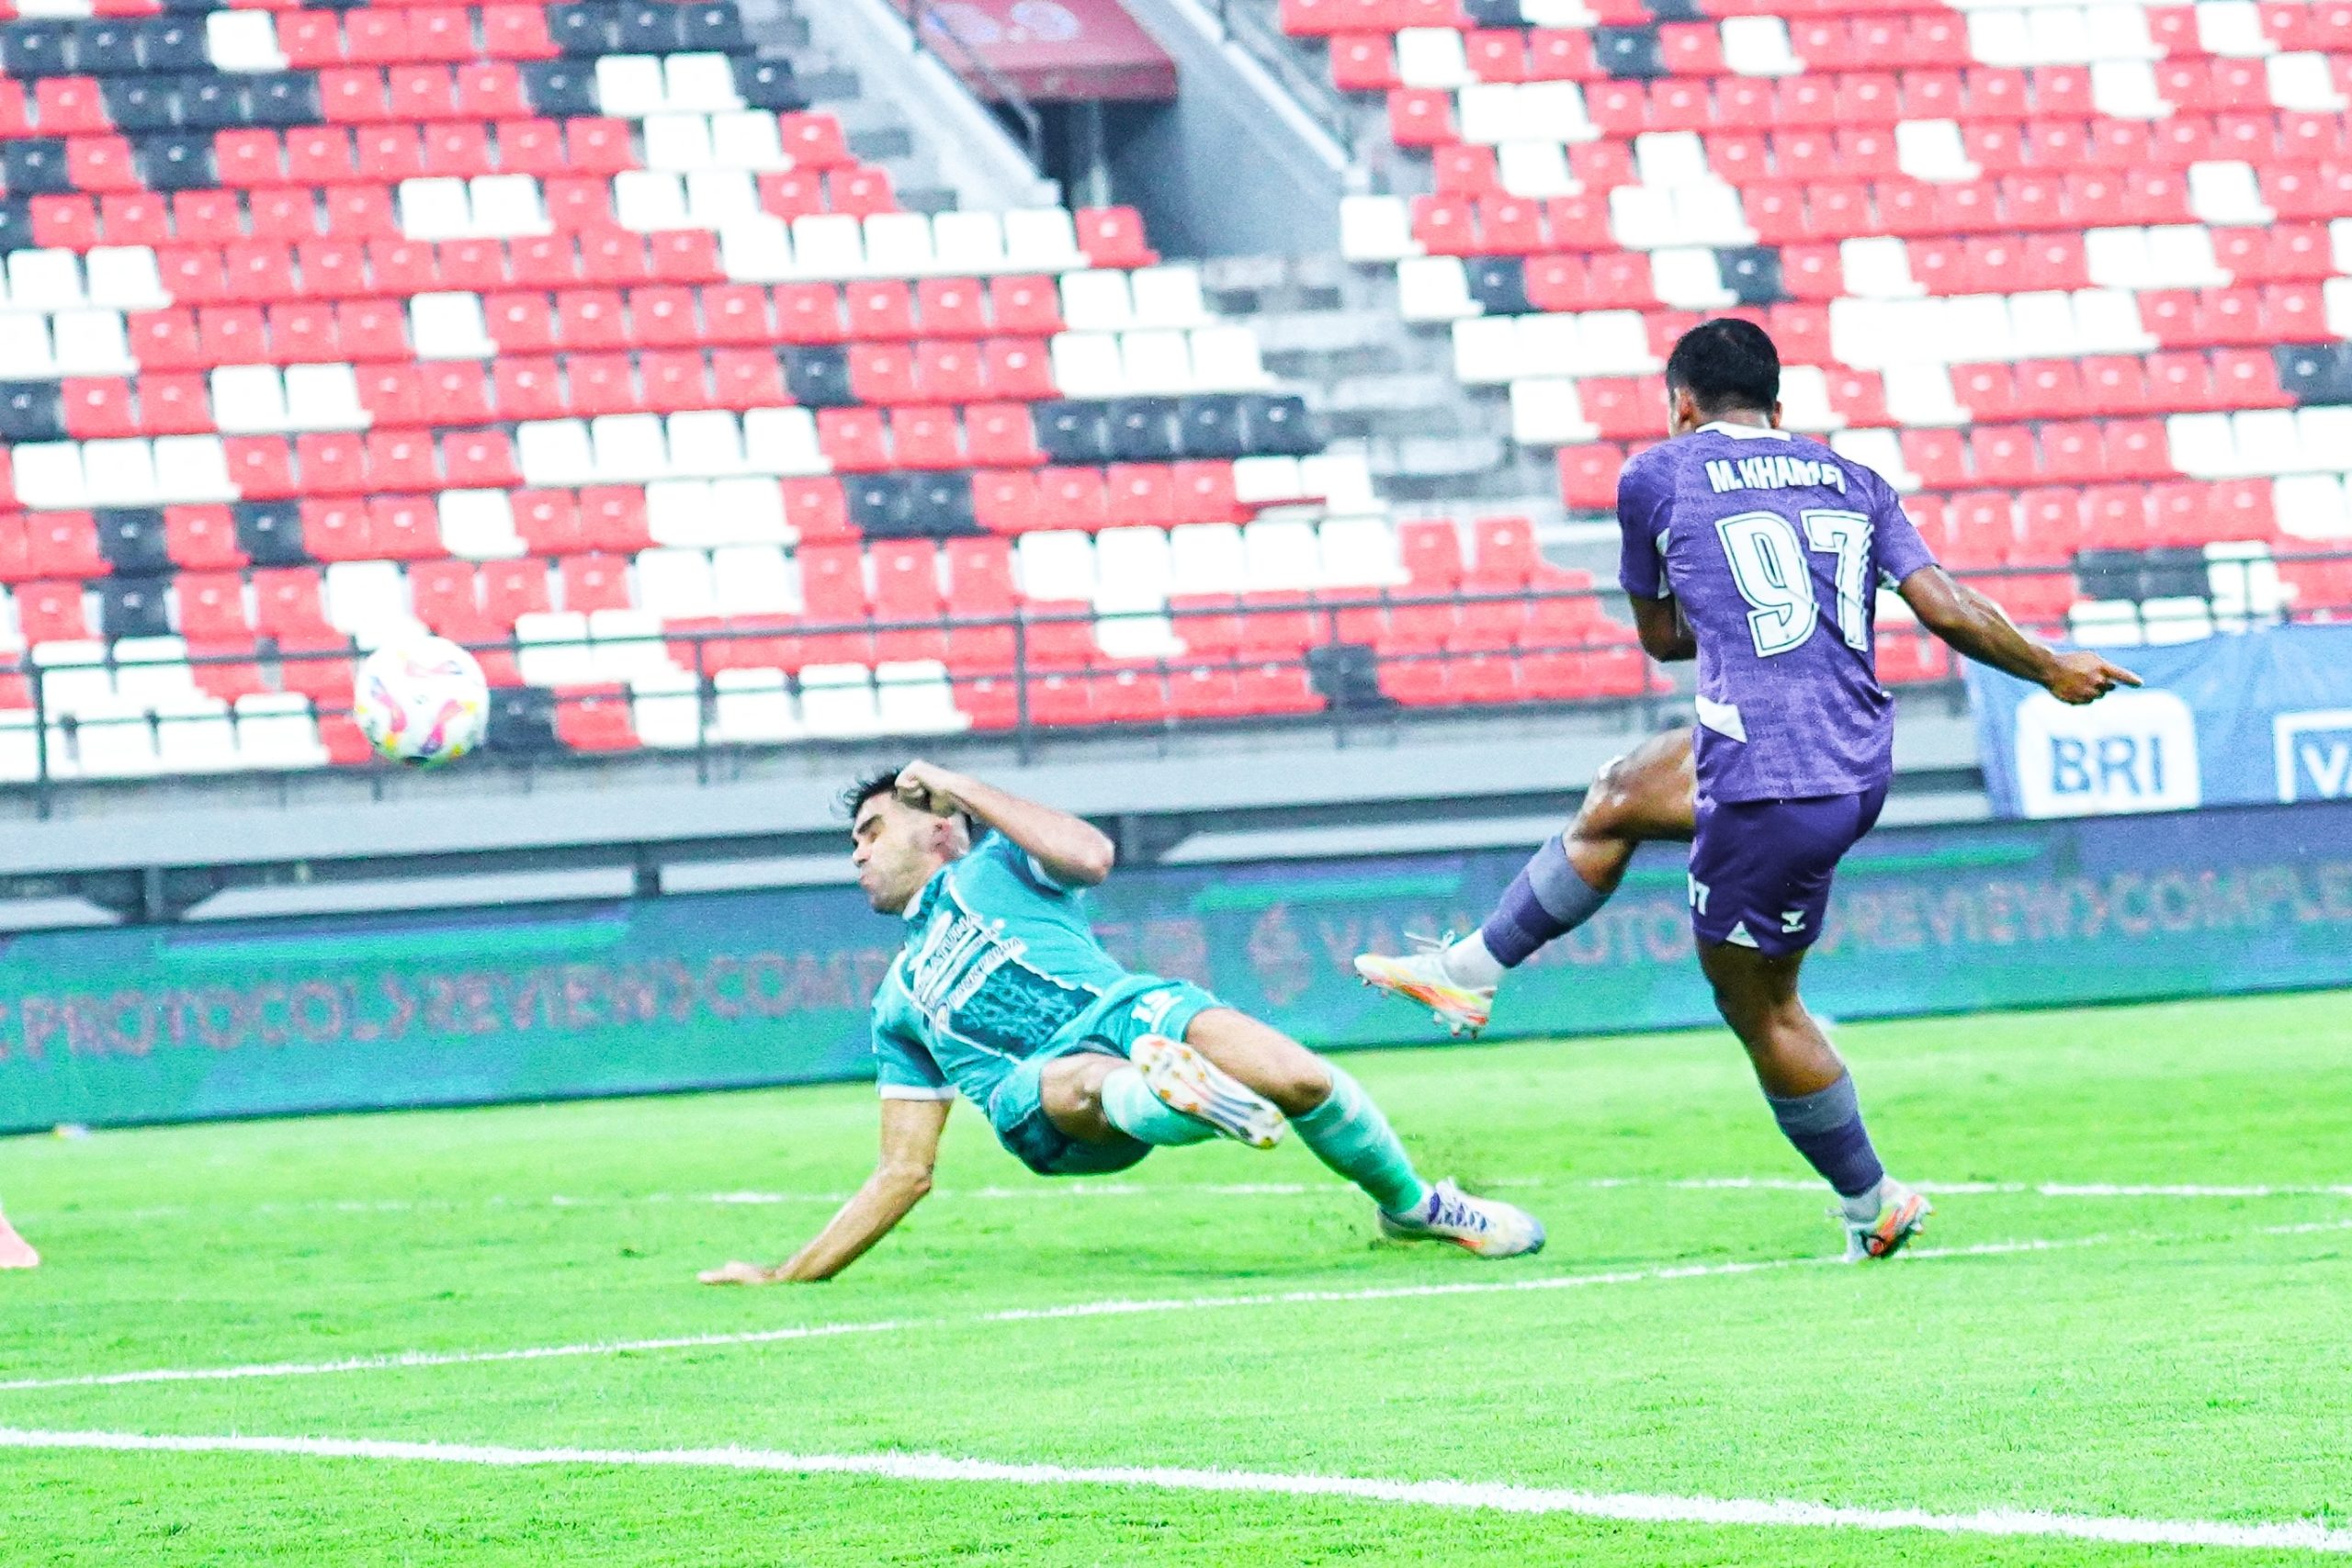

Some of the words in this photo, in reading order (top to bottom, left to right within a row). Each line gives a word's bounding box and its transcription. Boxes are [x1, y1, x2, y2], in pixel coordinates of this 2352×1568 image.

[1715, 508, 1874, 658] 97
[2049, 734, 2164, 796] BRI
[21, 976, 380, 1058] PROTOCOL
